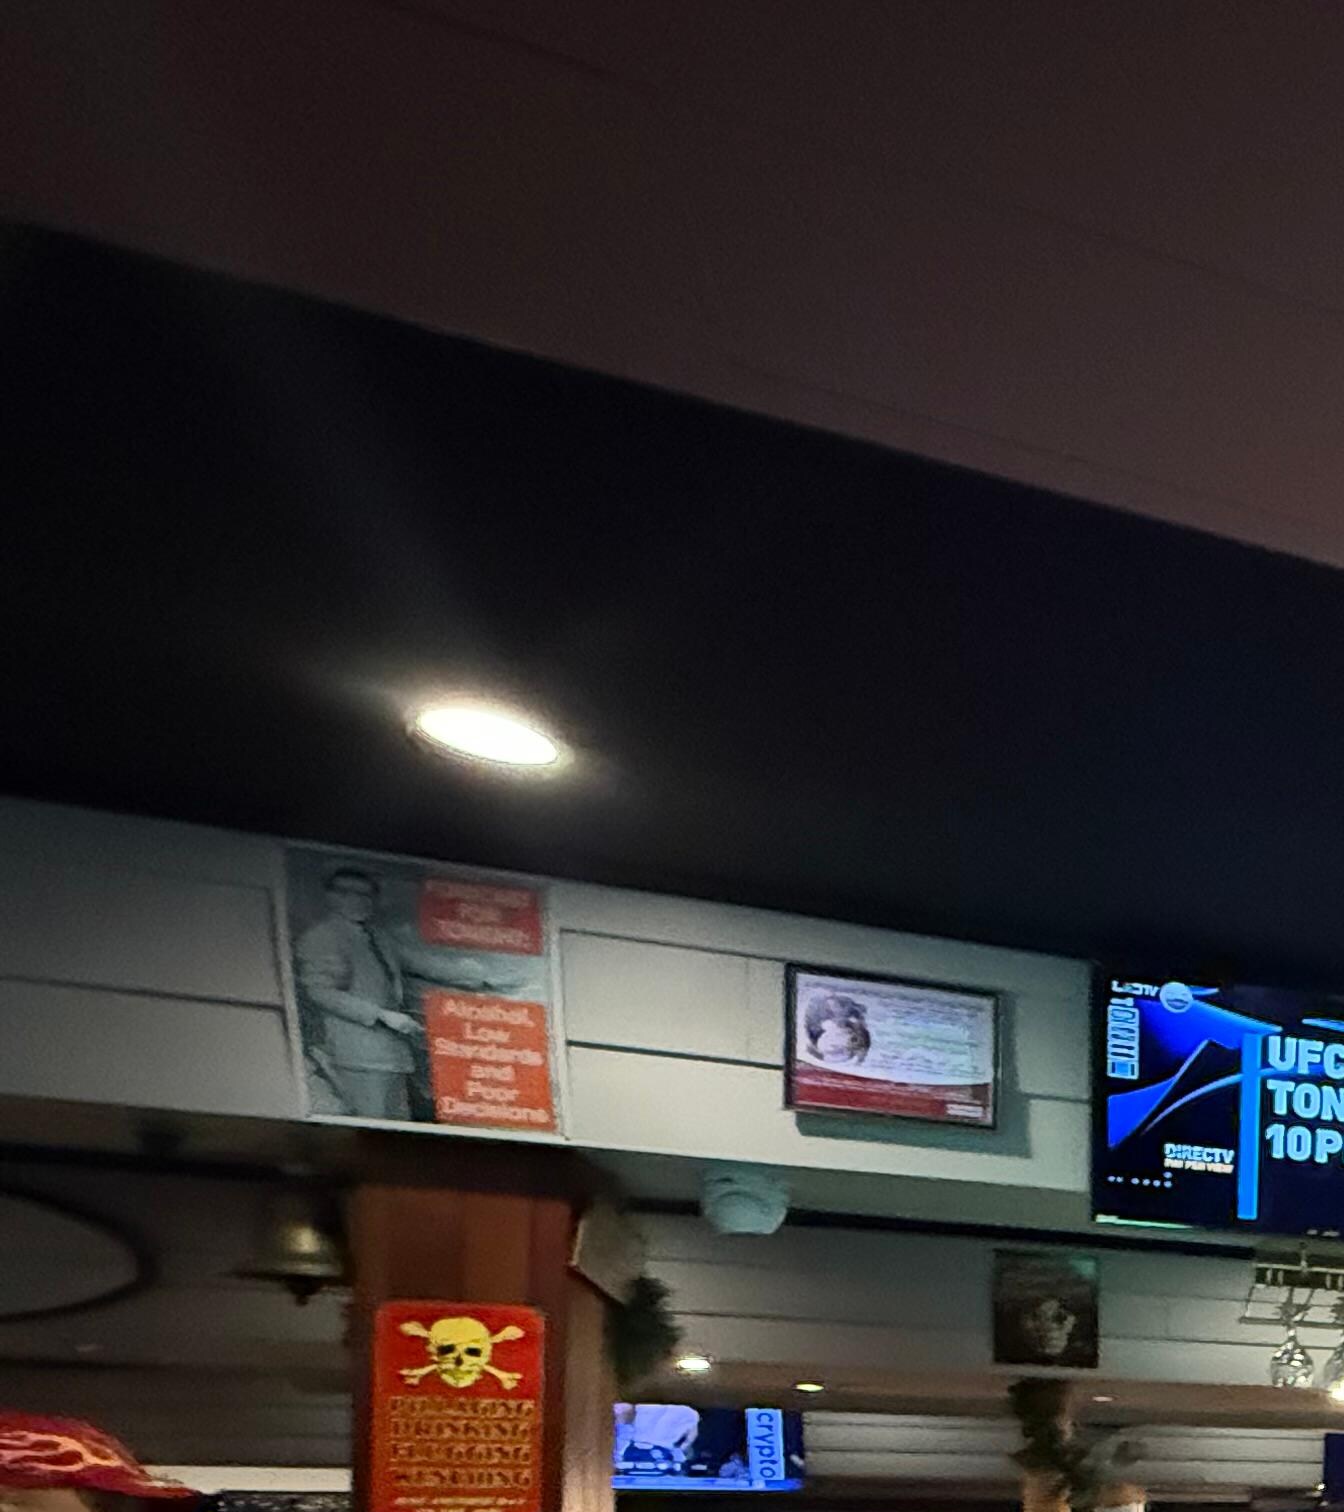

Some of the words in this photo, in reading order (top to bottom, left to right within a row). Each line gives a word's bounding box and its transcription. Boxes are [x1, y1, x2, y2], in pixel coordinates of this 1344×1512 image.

[464, 1022, 511, 1043] Low
[470, 1065, 516, 1081] and
[466, 1080, 520, 1102] Poor
[1163, 1143, 1235, 1164] DIRECTV
[389, 1418, 531, 1440] DRINKING
[753, 1412, 777, 1478] crypto
